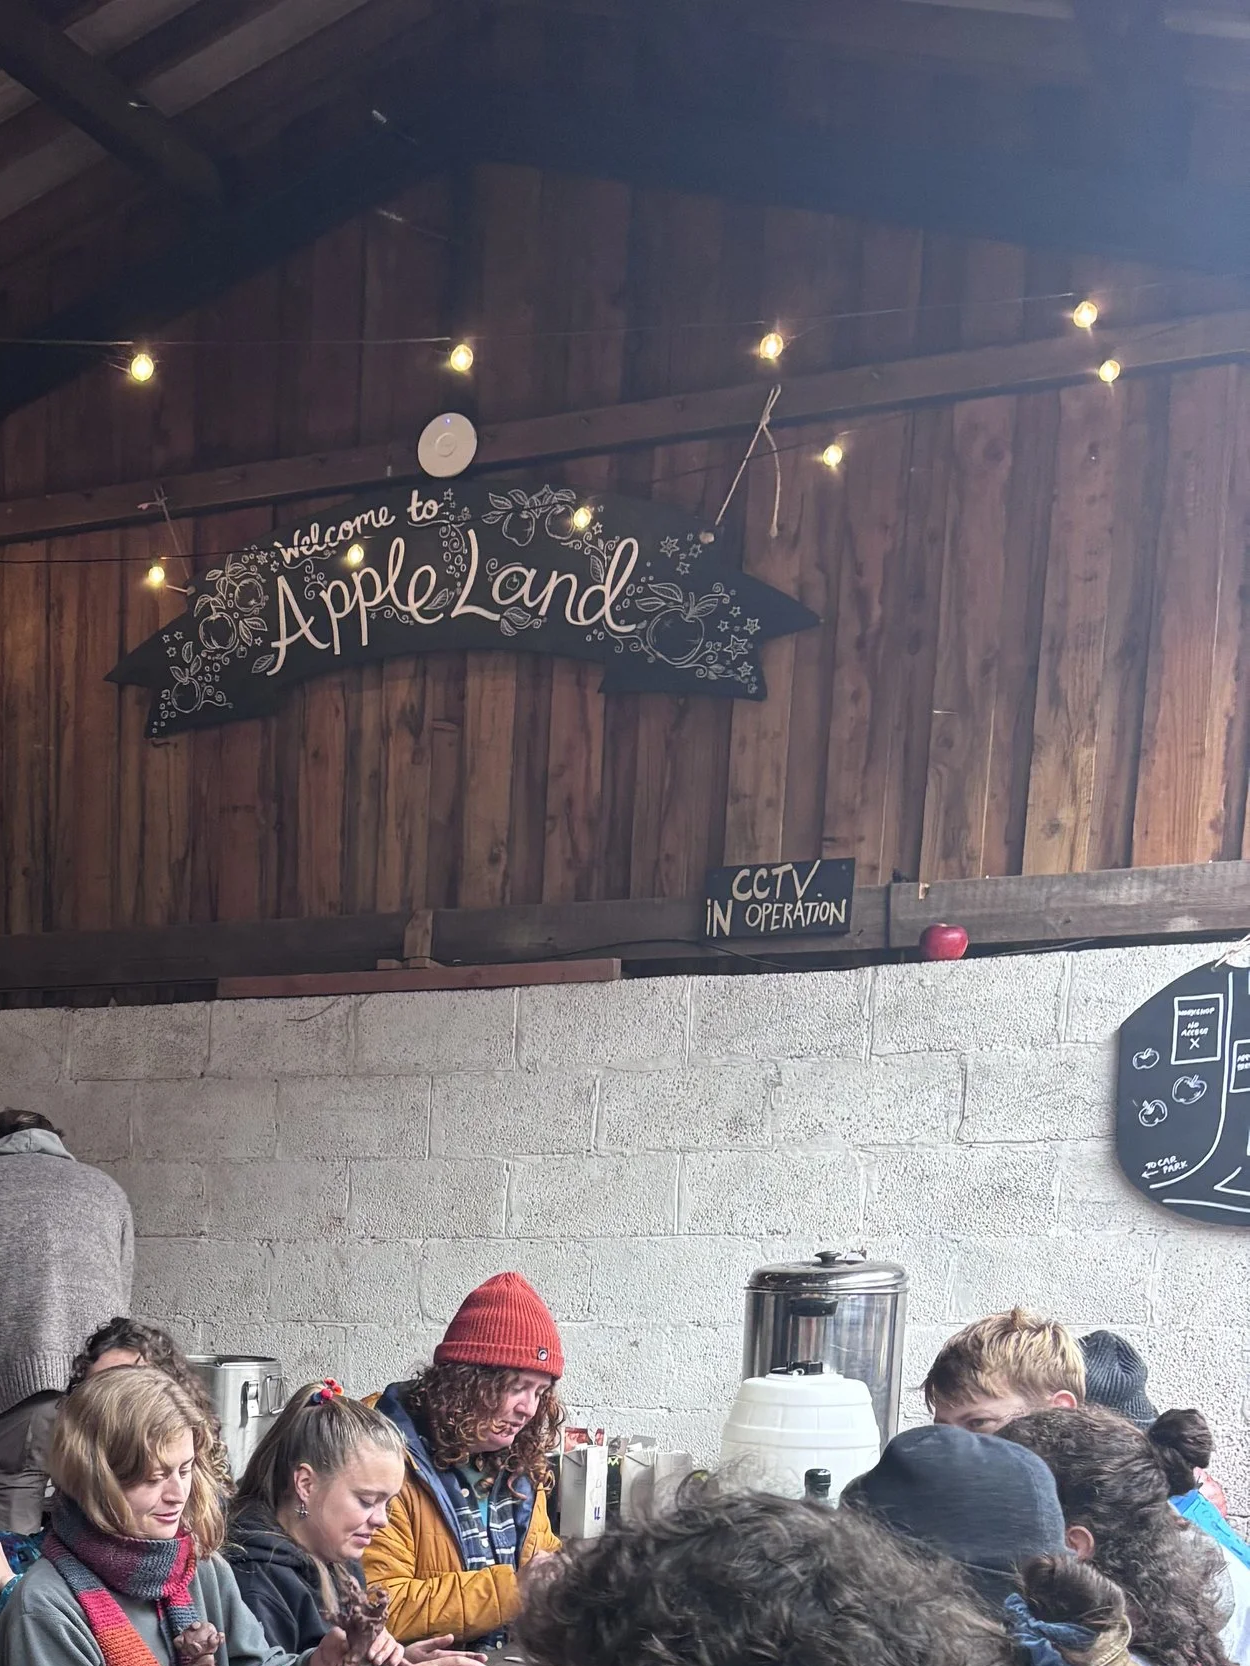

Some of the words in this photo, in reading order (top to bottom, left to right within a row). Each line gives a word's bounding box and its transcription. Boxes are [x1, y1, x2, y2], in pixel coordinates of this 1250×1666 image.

[407, 489, 444, 522] to
[1145, 1161, 1157, 1170] TO
[1157, 1155, 1177, 1167] CAR
[1162, 1160, 1188, 1175] PARK
